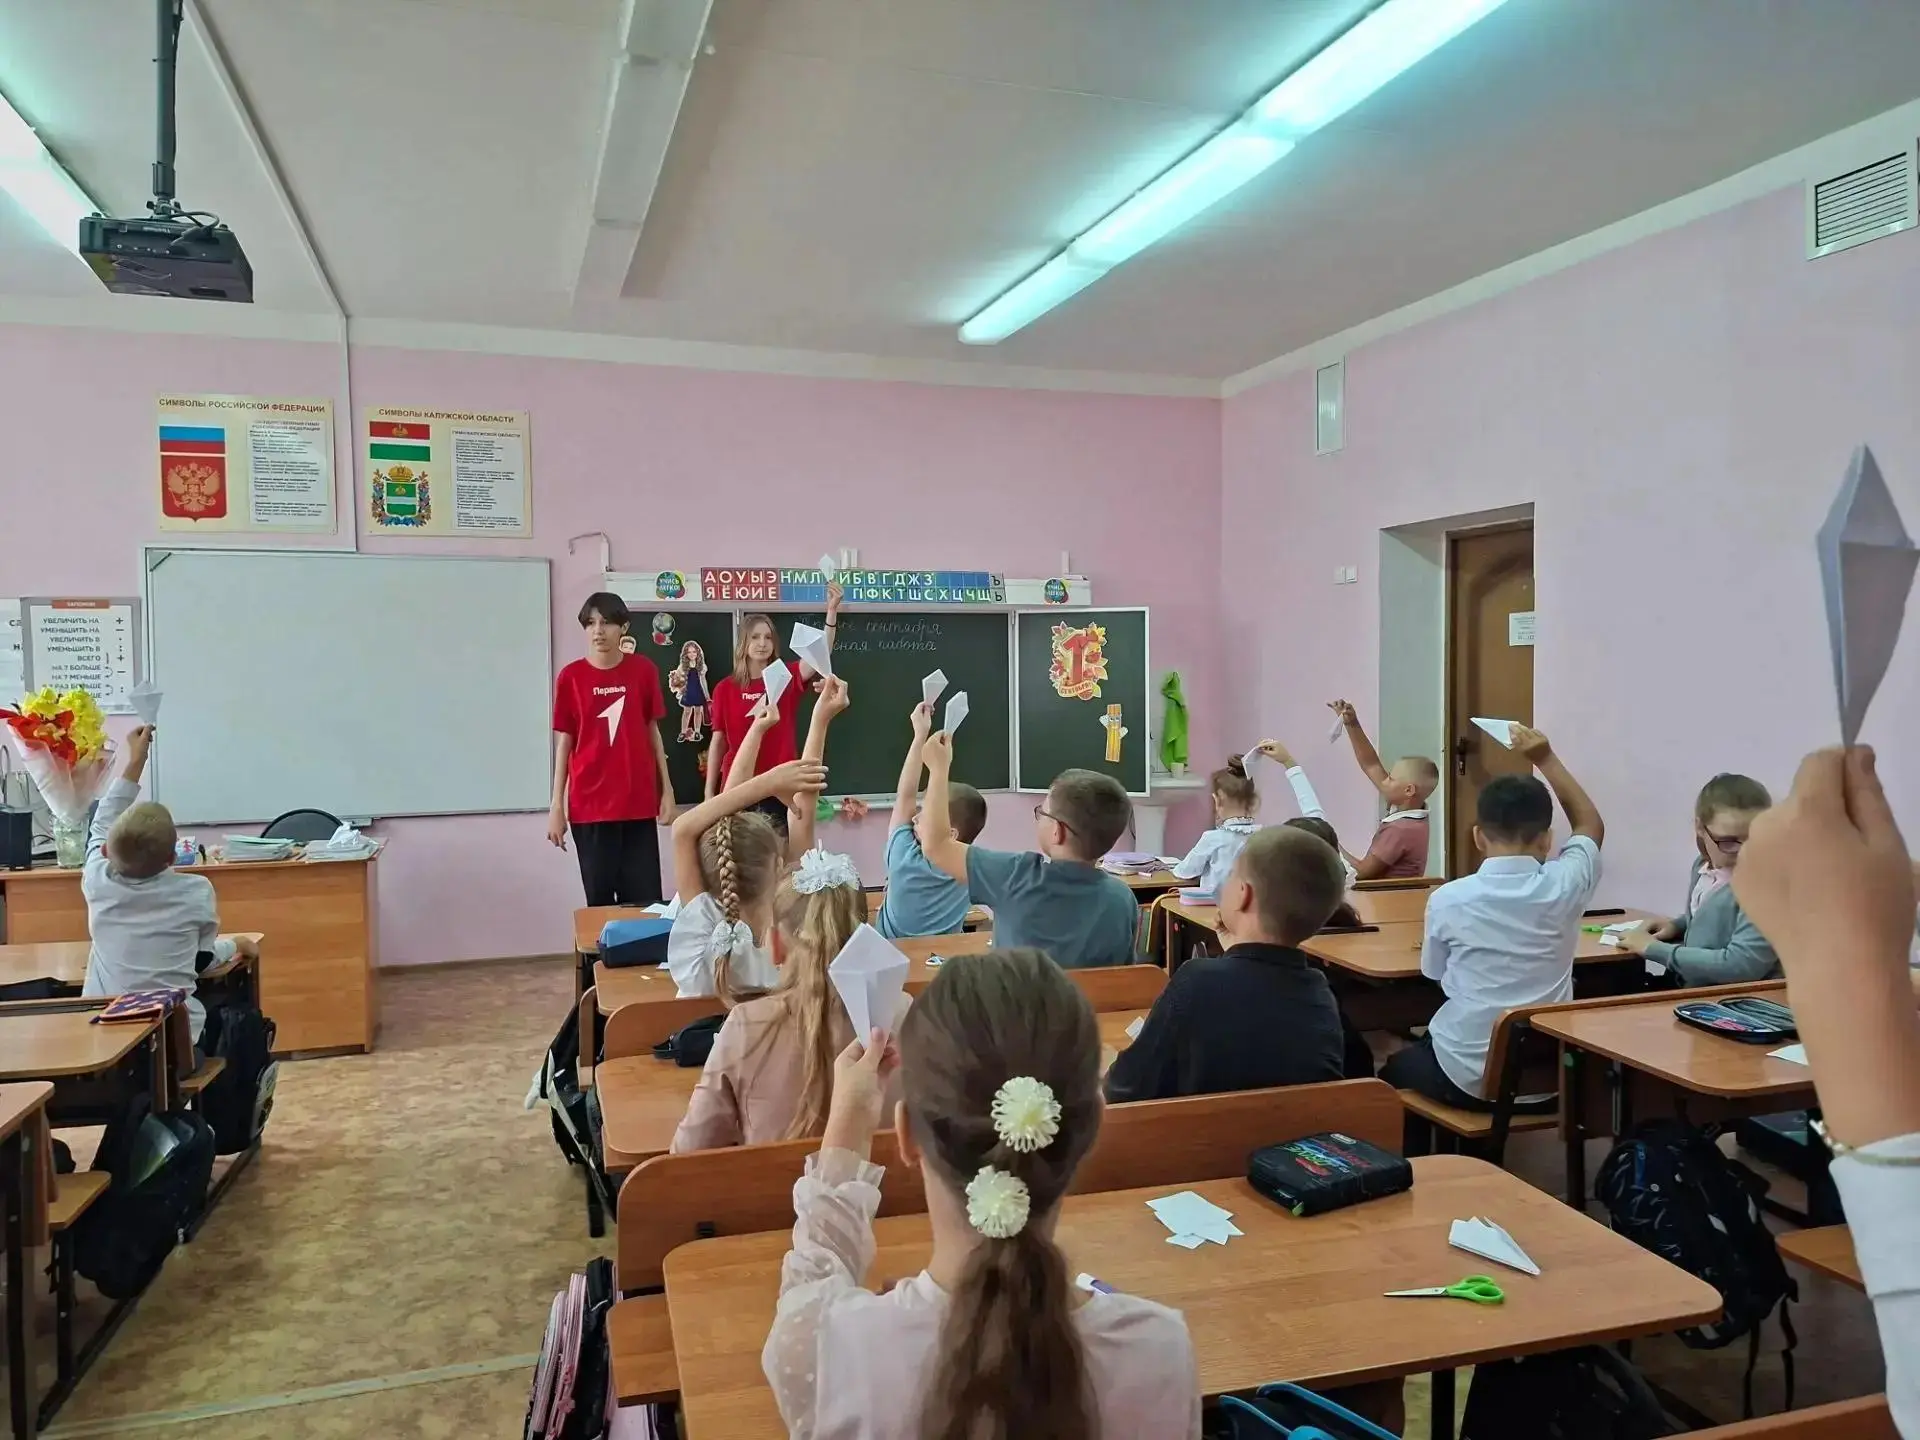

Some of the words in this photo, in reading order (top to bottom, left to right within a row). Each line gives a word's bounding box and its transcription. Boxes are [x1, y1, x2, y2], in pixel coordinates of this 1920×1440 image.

[159, 399, 206, 407] СИМВОЛЫ
[208, 400, 269, 410] РОССИЙСКОЙ
[271, 403, 325, 413] ФЕДЕРАЦИИ
[379, 409, 422, 418] СИМВОЛЫ
[424, 412, 474, 421] КАЛУЖСКОЙ
[476, 414, 514, 423] ОБЛАСТИ
[593, 685, 626, 696] Первые
